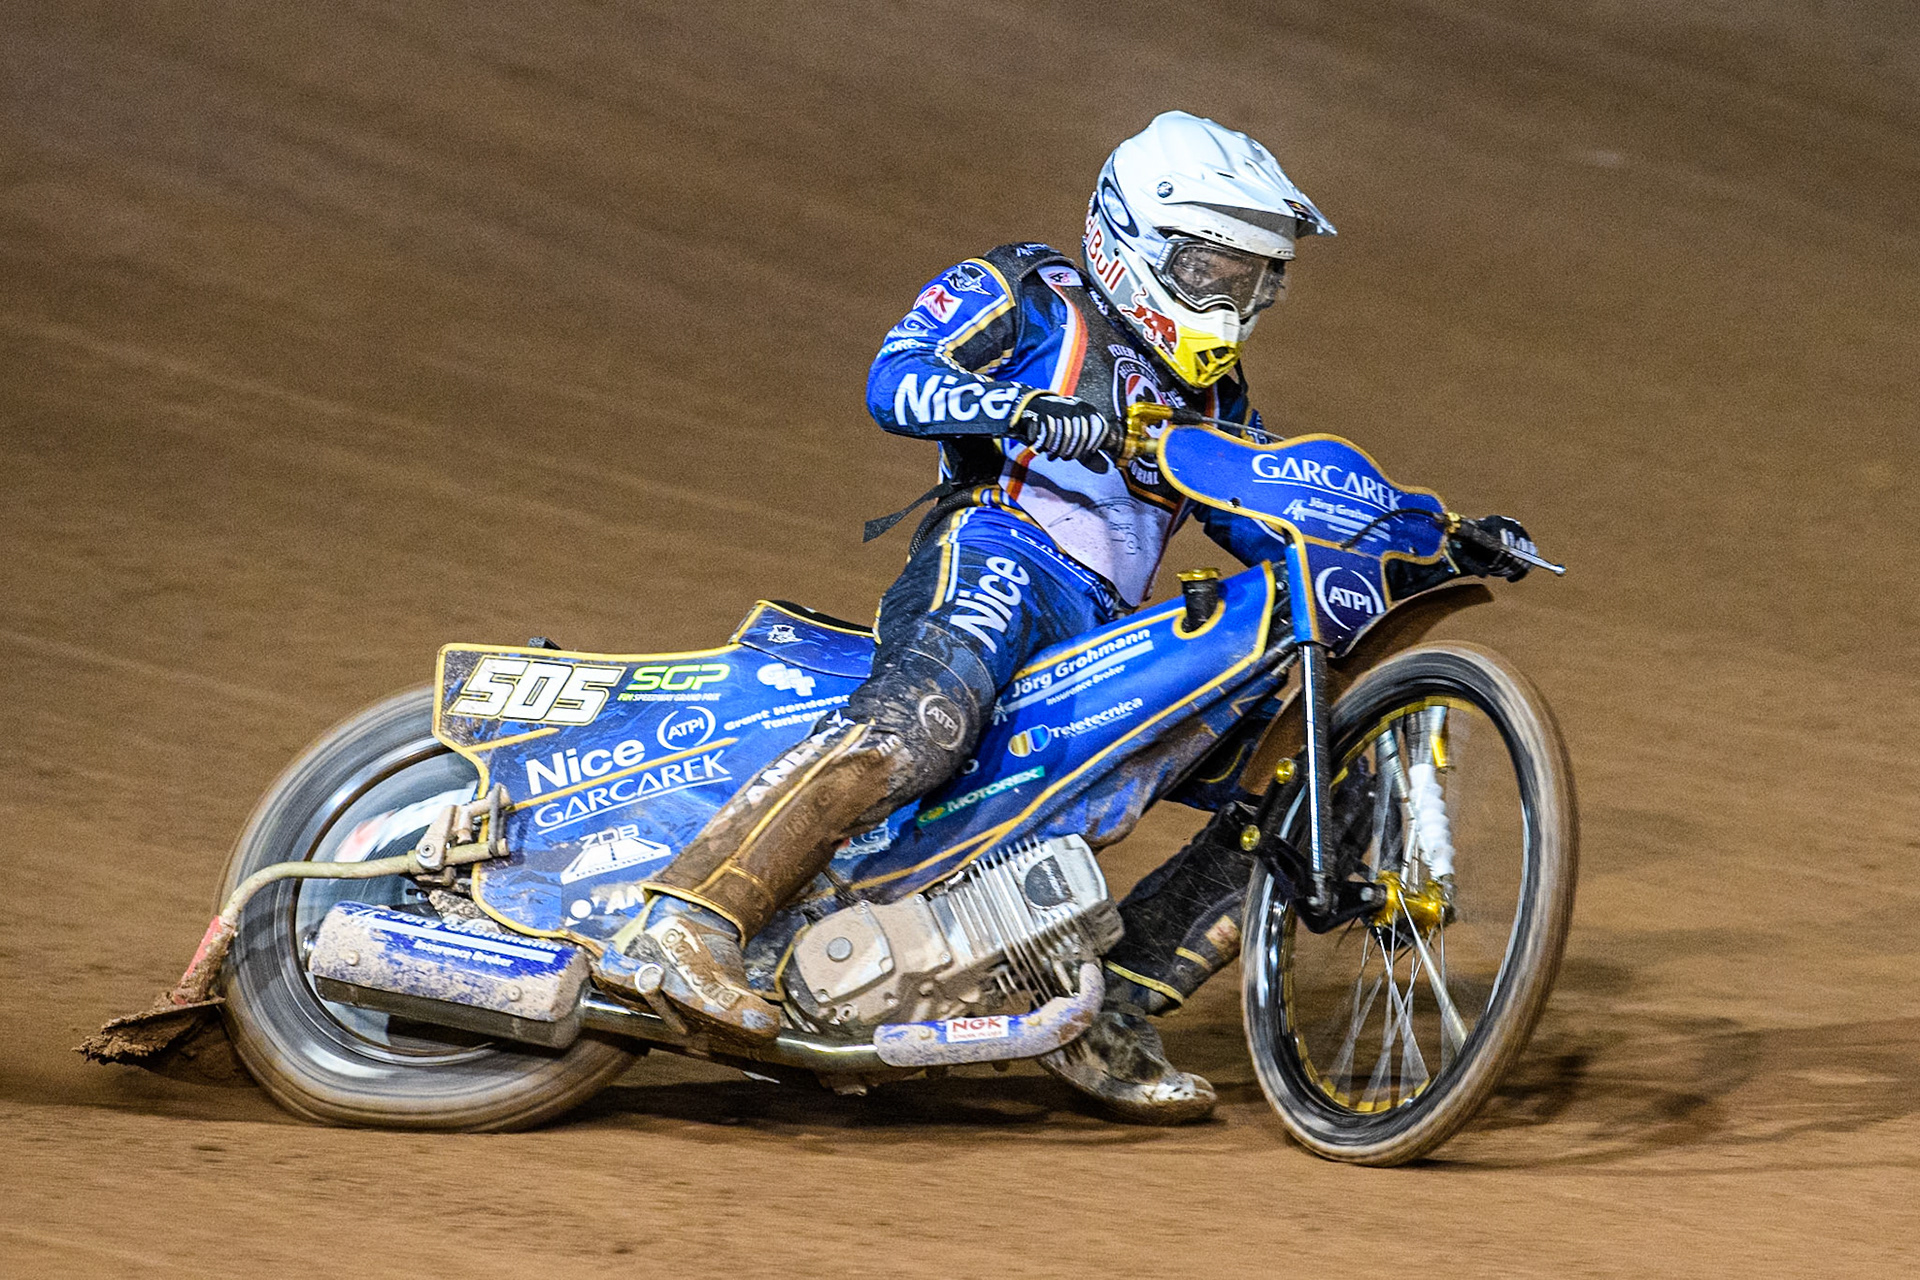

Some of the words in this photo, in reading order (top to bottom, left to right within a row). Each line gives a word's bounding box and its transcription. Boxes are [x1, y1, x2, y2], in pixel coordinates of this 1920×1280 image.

[1087, 229, 1126, 291] Bull
[894, 373, 1019, 426] Nice
[1251, 453, 1402, 510] GARCAREK
[950, 556, 1030, 653] Nice
[1328, 586, 1374, 614] ATPI
[625, 663, 731, 691] SGP
[1012, 672, 1052, 697] Jörg
[1054, 629, 1150, 678] Grohmann
[449, 655, 627, 727] 505
[667, 717, 705, 740] ATPI
[723, 710, 770, 731] Grant
[926, 705, 959, 736] ATPI
[1051, 697, 1143, 738] Teletecnica
[525, 739, 645, 796] Nice
[534, 749, 731, 828] GARCAREK
[947, 769, 1040, 812] MOTOREX
[952, 1017, 1002, 1032] NGK
